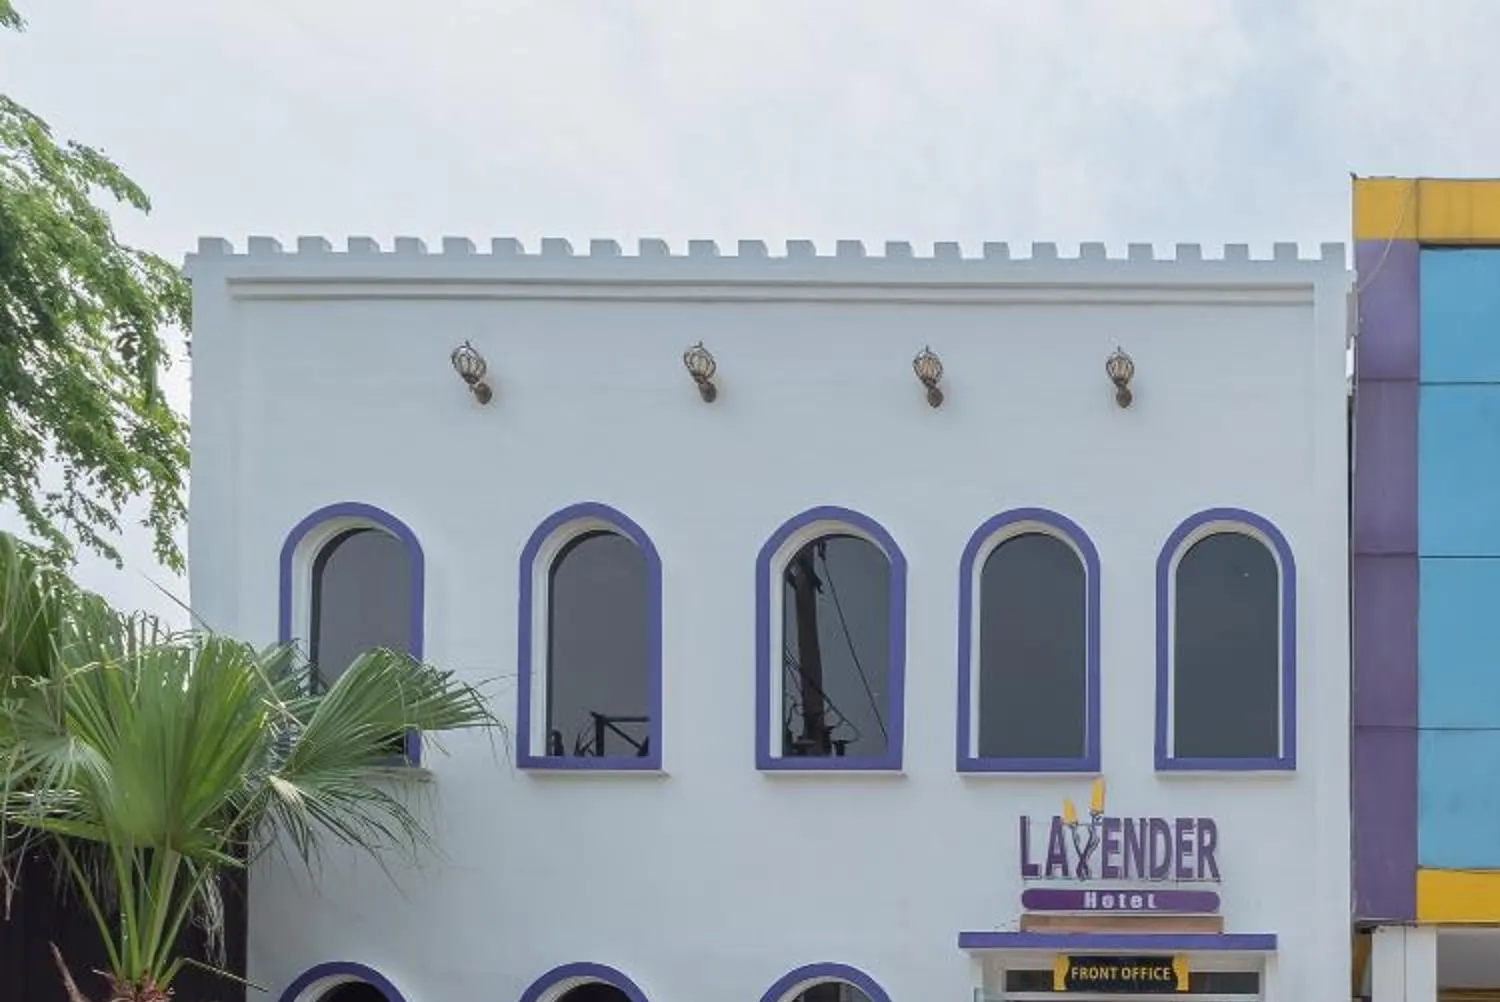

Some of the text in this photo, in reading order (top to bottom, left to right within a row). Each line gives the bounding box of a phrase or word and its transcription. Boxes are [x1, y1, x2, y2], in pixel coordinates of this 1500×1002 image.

[1019, 815, 1222, 882] LAVENDER
[1084, 891, 1158, 909] Hotel
[1071, 966, 1172, 980] FRONT OFFICE
